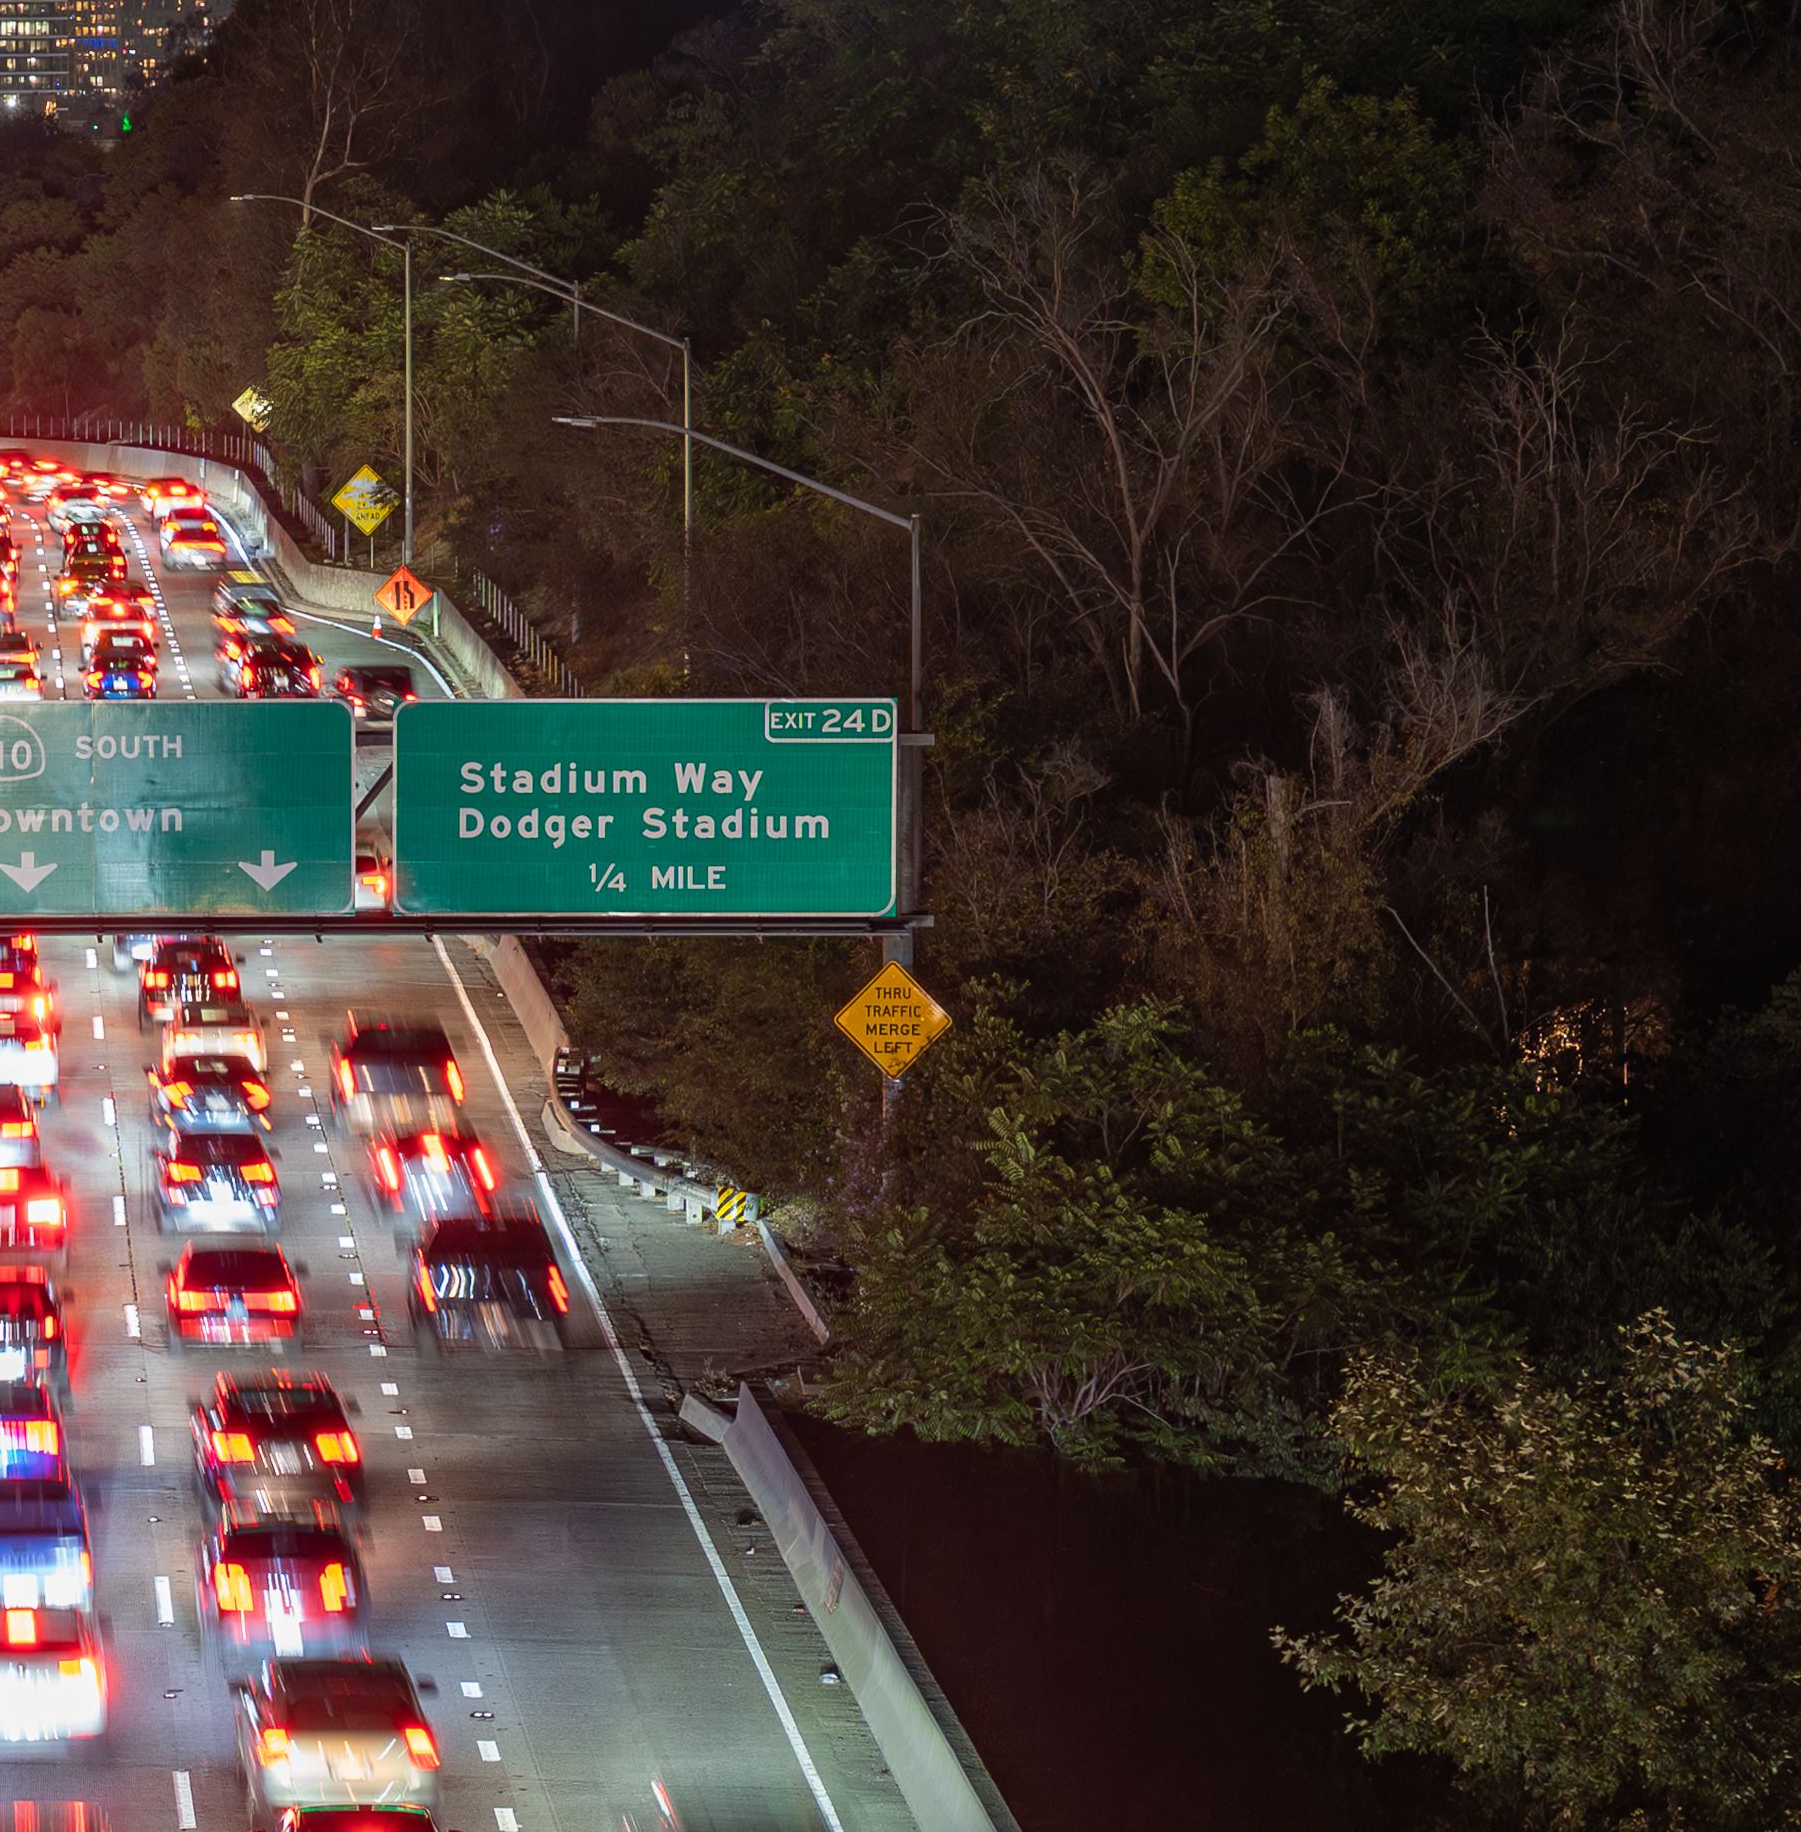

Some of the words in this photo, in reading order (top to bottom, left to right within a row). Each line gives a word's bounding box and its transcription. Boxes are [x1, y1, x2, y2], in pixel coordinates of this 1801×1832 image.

[770, 712, 817, 729] EXIT
[74, 735, 184, 760] SOUTH
[460, 761, 647, 795] Stadium
[674, 762, 764, 802] Way
[459, 807, 614, 850] Dodger
[641, 807, 830, 840] Stadium
[651, 865, 727, 890] MILE
[875, 987, 912, 1000] THRU
[865, 1005, 922, 1018] TRAFFIC
[865, 1024, 922, 1036] MERGE
[874, 1041, 914, 1054] LEFT
